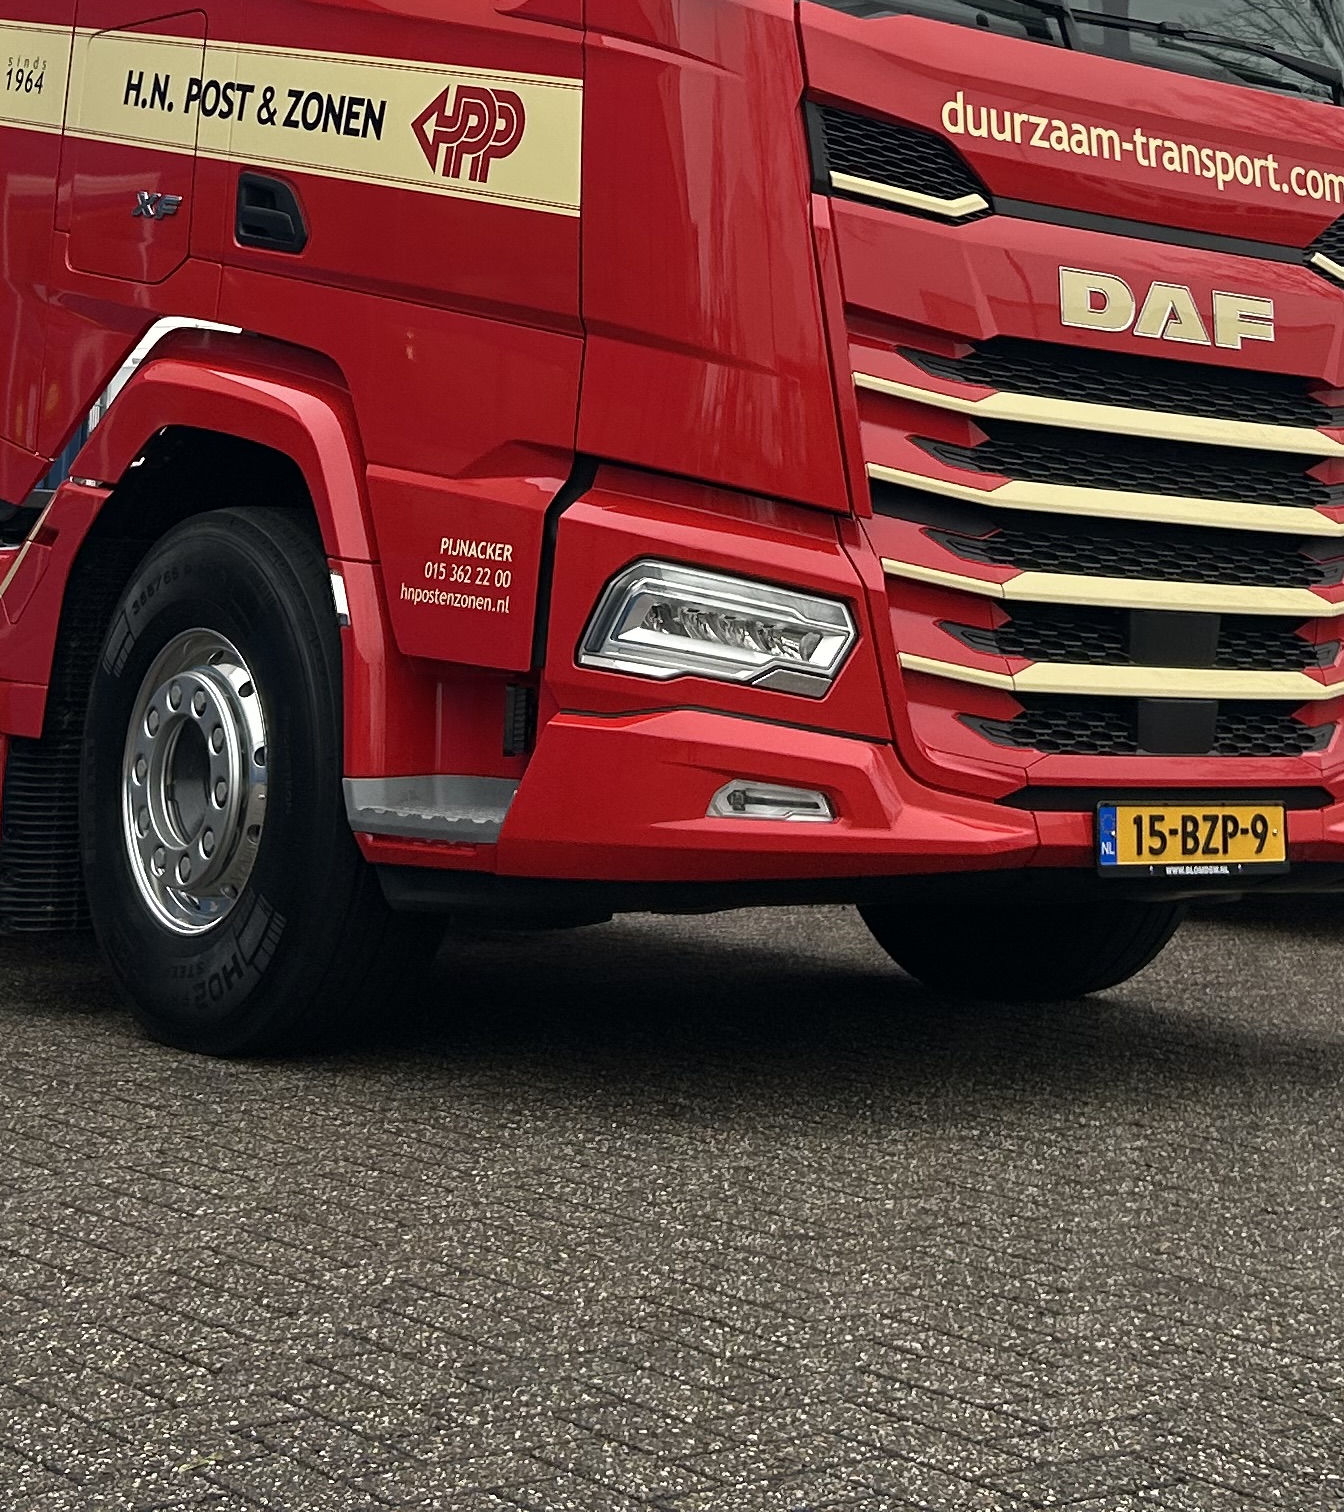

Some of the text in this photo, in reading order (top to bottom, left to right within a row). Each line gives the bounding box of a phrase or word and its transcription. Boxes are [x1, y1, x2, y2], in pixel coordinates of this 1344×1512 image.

[6, 68, 45, 94] 1964
[123, 70, 174, 112] H.N.
[184, 78, 255, 121] POST
[257, 90, 278, 126] &
[282, 91, 387, 141] ZONEN
[131, 190, 183, 219] XF
[1058, 265, 1275, 350] DAF
[440, 537, 513, 562] PIJNACKER
[424, 561, 512, 588] 015 362 22 00
[400, 582, 510, 614] hnpostenzonen.nl
[1101, 813, 1269, 856] NL 15-BZP-9
